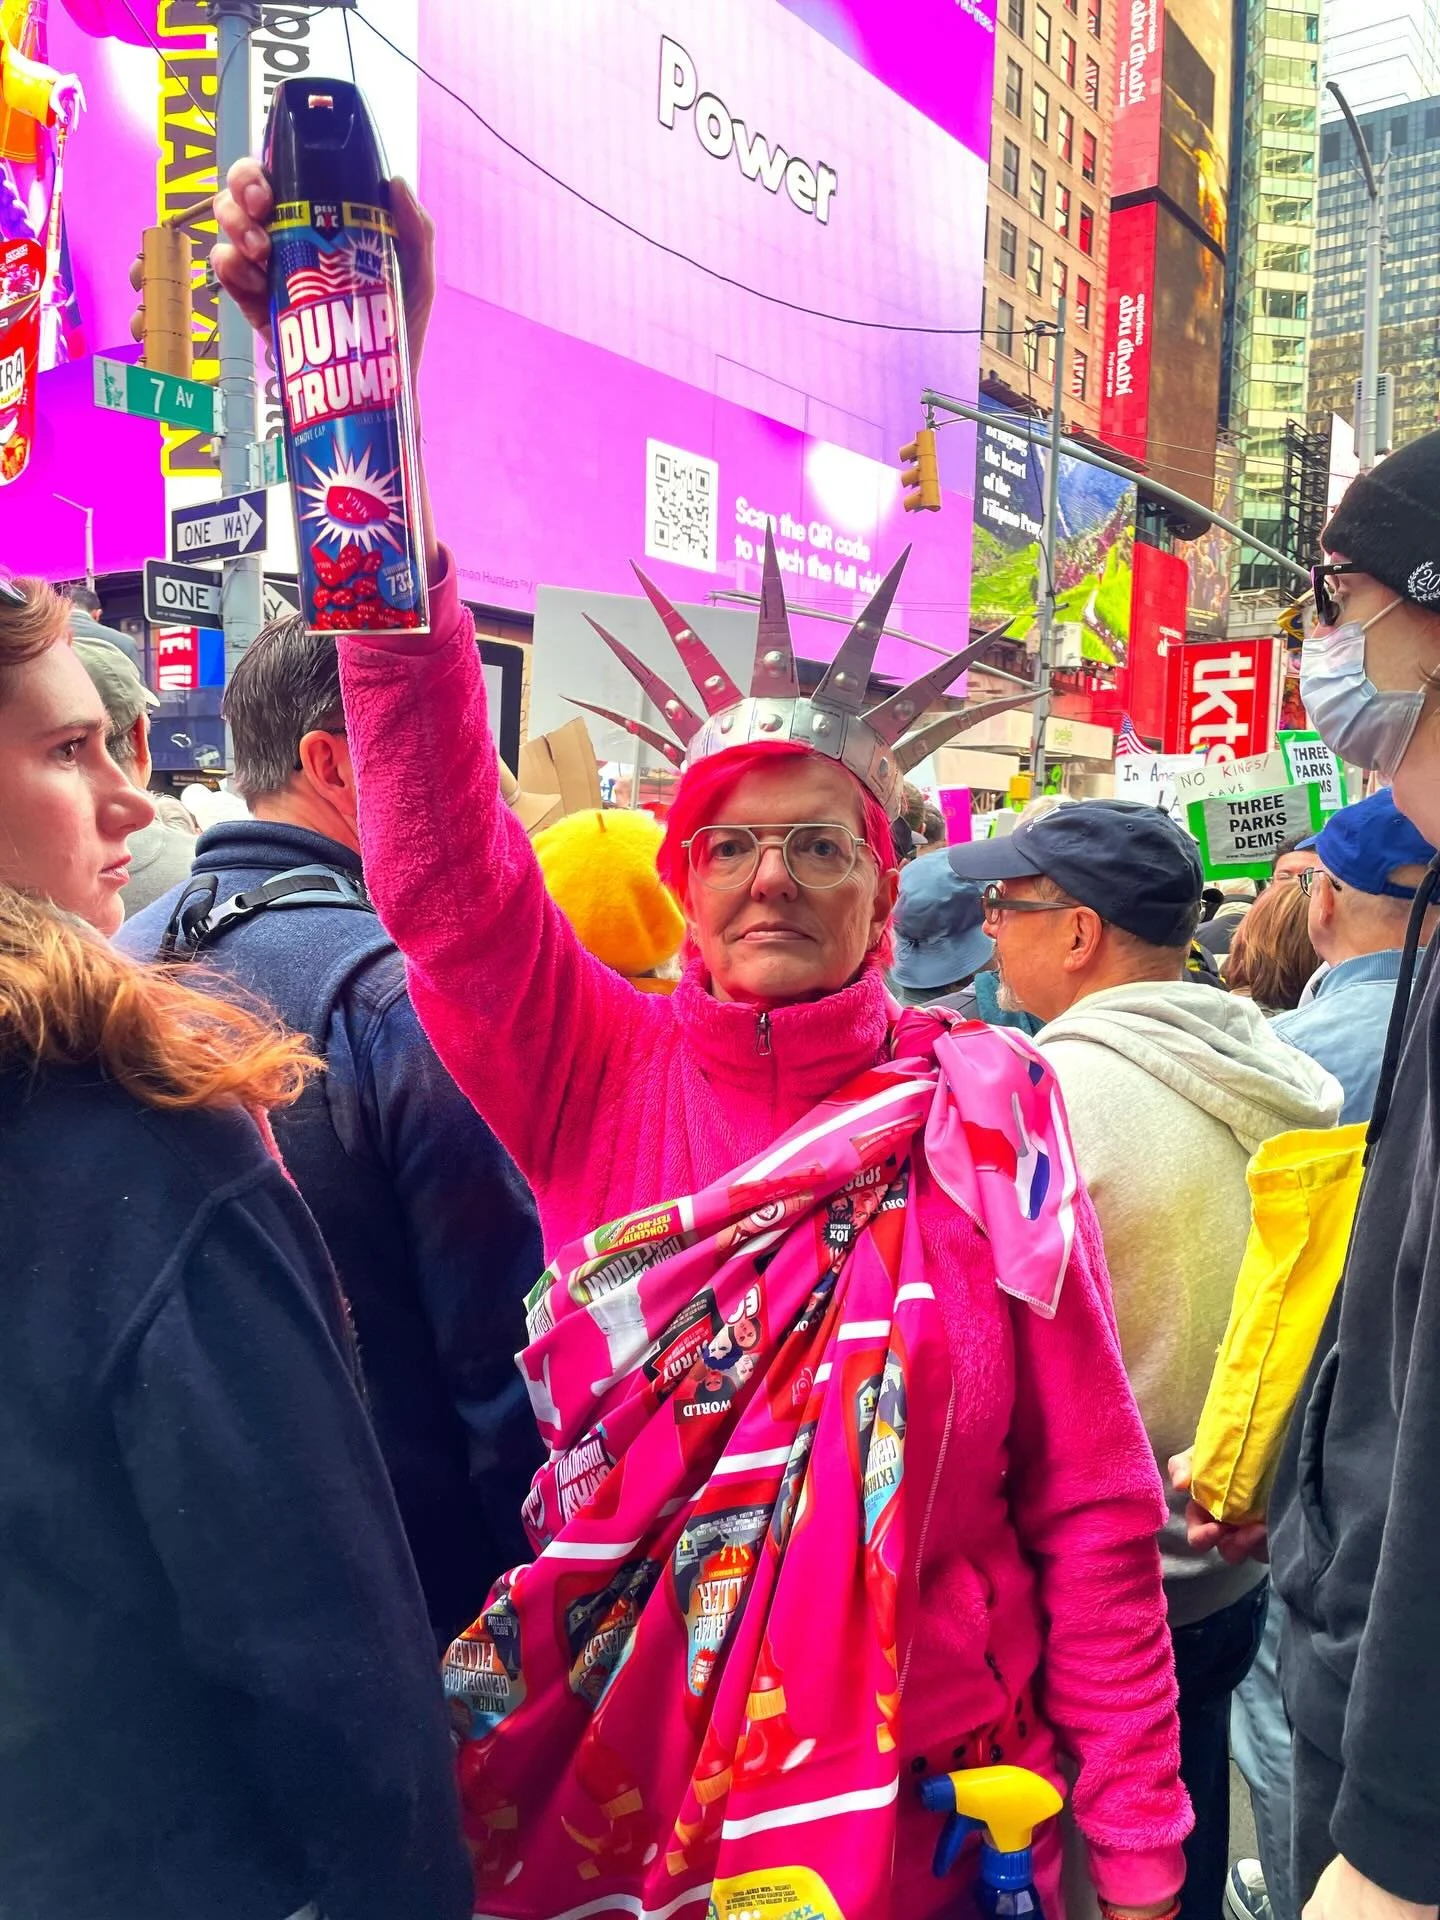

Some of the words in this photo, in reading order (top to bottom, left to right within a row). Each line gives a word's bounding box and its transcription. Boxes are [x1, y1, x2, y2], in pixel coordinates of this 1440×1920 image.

[1128, 42, 1147, 104] dhabi
[658, 34, 838, 226] Power
[1118, 295, 1137, 336] abu
[279, 293, 395, 378] DUMP
[1115, 338, 1136, 396] dhabi
[151, 378, 165, 413] 7
[175, 386, 194, 408] Av
[288, 356, 398, 424] TRUMP
[984, 444, 1001, 467] the
[1002, 451, 1027, 479] heart
[983, 472, 996, 491] of
[995, 476, 1011, 498] the
[982, 497, 1020, 527] Filipino
[185, 522, 211, 547] ONE
[224, 512, 252, 539] WAY
[735, 496, 776, 534] Scan
[779, 512, 806, 542] the
[808, 521, 833, 551] QR
[835, 535, 871, 562] code
[735, 534, 754, 560] to
[807, 554, 832, 582] the
[833, 561, 857, 590] full
[162, 581, 210, 610] ONE
[1293, 746, 1329, 761] THREE
[1124, 765, 1139, 782] In
[1180, 772, 1206, 789] NO
[1222, 756, 1270, 778] KINGS!
[1295, 763, 1333, 778] PARKS
[1227, 793, 1286, 816] THREE
[1229, 812, 1288, 833] PARKS
[1235, 830, 1286, 850] DEMS
[829, 1230, 849, 1242] 10x
[683, 1399, 732, 1417] WORLD
[450, 1637, 495, 1672] FILLER
[463, 1667, 510, 1697] GENDER
